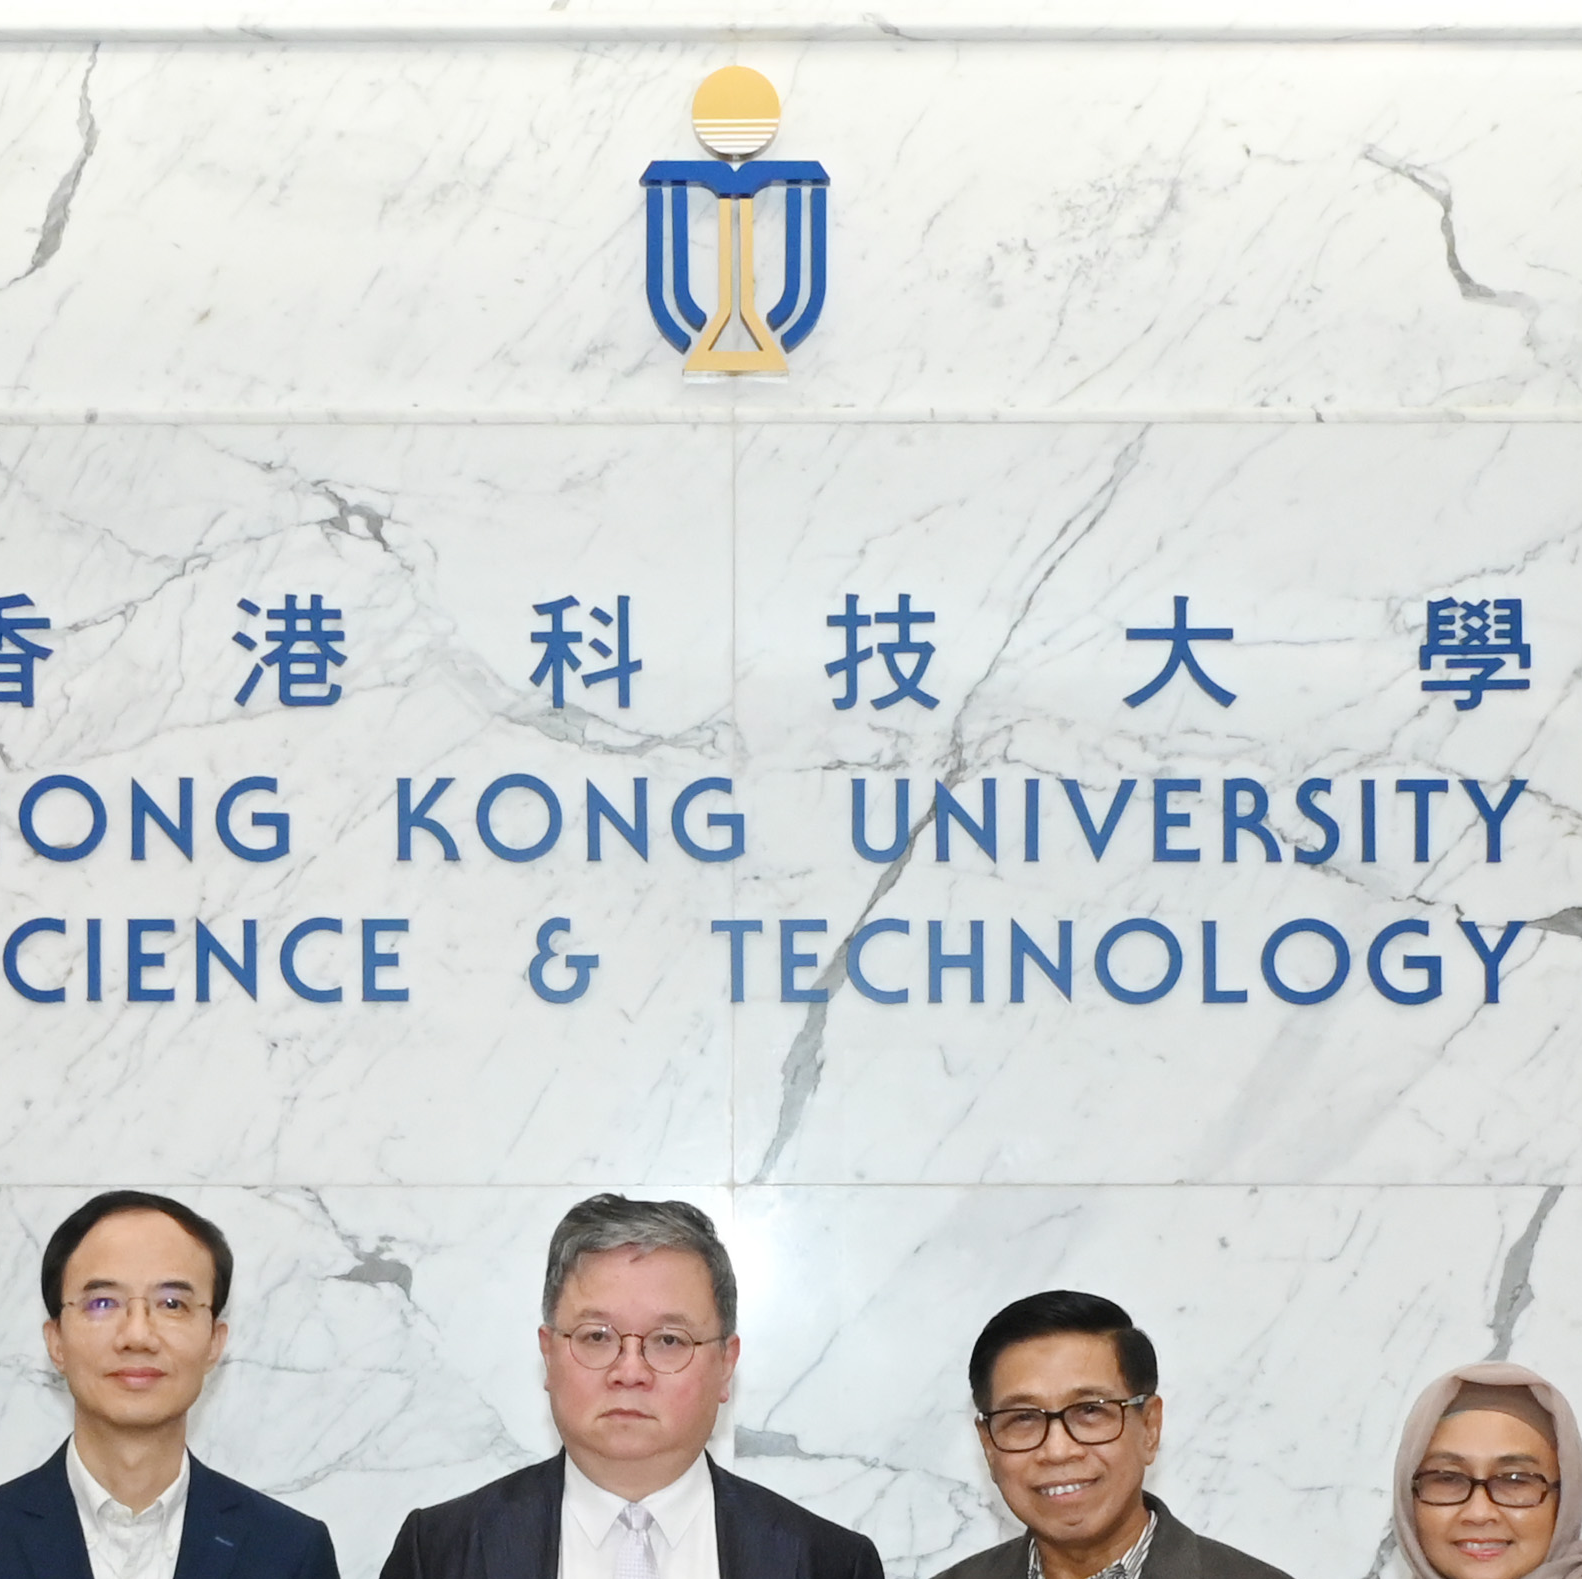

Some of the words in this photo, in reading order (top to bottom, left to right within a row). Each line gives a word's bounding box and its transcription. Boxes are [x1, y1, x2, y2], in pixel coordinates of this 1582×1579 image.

[398, 774, 745, 863] KONG
[853, 777, 1529, 865] UNIVERSITY
[530, 917, 599, 1004] &
[712, 918, 1526, 1006] TECHNOLOGY
